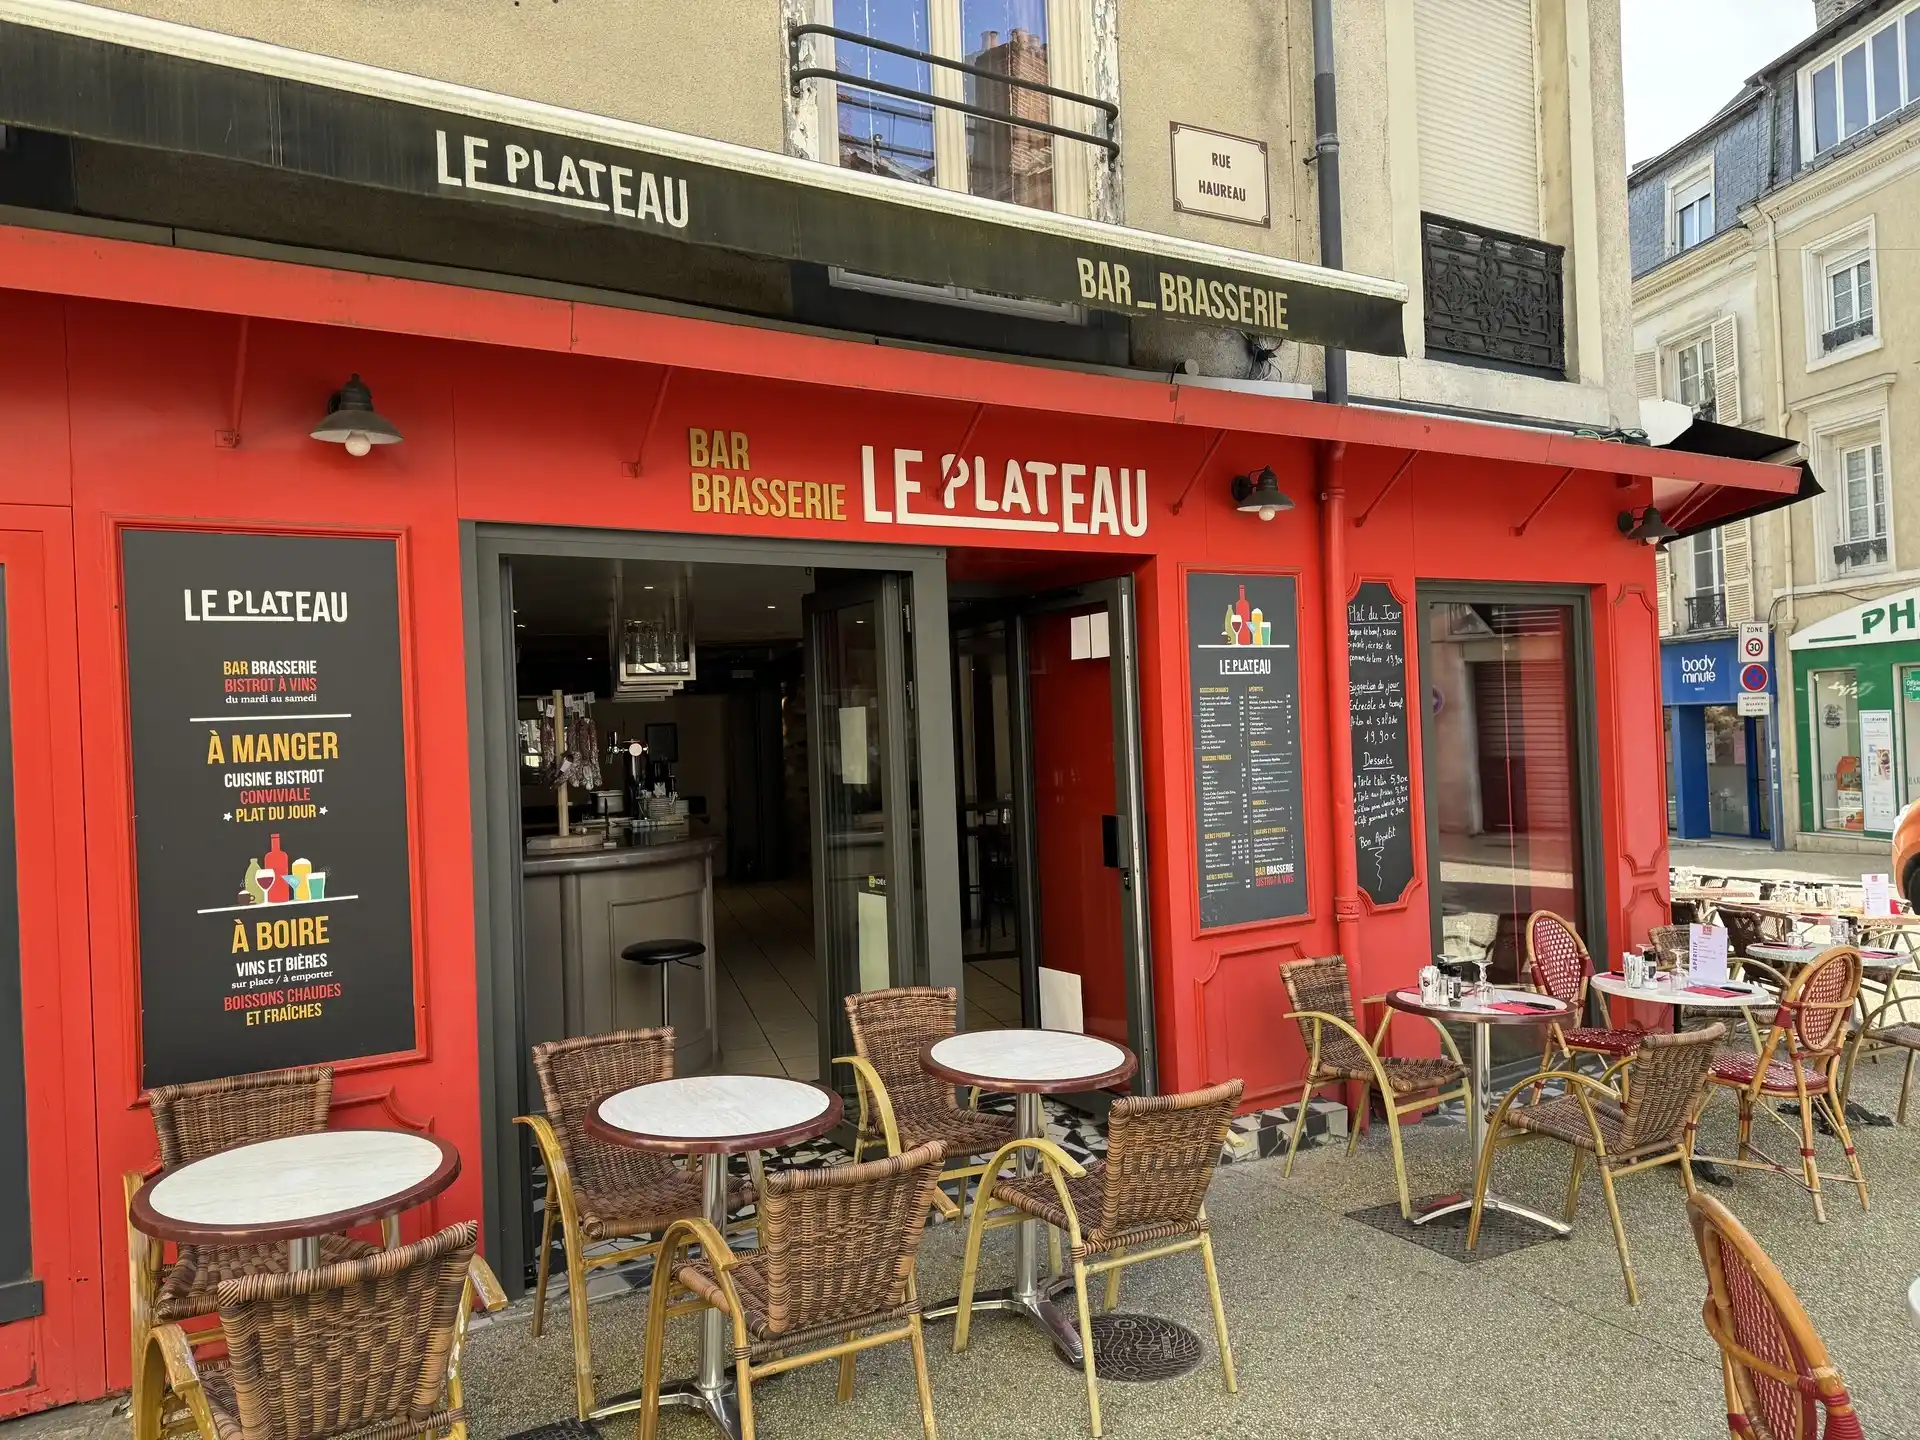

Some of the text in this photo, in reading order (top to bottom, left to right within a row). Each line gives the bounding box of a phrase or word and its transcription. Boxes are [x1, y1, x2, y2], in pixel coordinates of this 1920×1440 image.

[1211, 152, 1231, 169] RUE
[436, 130, 689, 229] LE PLATEAU
[1198, 180, 1246, 202] HAUREAU
[689, 428, 750, 470] BAR
[691, 473, 847, 521] BRASSERIE
[861, 445, 1149, 538] LE PLATEAU
[184, 589, 348, 623] LE PLATEAU
[1348, 604, 1402, 622] Plat du Jour
[1861, 598, 1920, 635] PH
[1385, 640, 1392, 650] de
[1749, 643, 1760, 652] 30
[223, 660, 318, 675] BAR BRASSERIE
[1219, 658, 1271, 675] LE PLATEAU
[1681, 654, 1716, 672] body
[225, 675, 318, 693] BISTROT À VINS
[1682, 671, 1716, 684] minute
[1377, 679, 1385, 690] du
[1385, 679, 1400, 696] jour
[225, 695, 239, 704] du
[241, 694, 269, 703] mardi
[284, 693, 317, 703] samedi
[1379, 698, 1386, 709] de
[1376, 711, 1398, 725] salade
[207, 729, 339, 765] À MANGER
[1362, 751, 1393, 768] Desserts
[224, 769, 325, 788] CUISINE BISTROT
[240, 787, 311, 805] CONVIVIALE
[236, 804, 317, 823] PLAT DU JOUR
[1359, 835, 1371, 849] Bon
[1255, 863, 1295, 876] BAR BRASSERIE
[1255, 875, 1277, 887] BISTROT
[231, 915, 330, 954] À BOIRE
[236, 953, 328, 977] VINS ET BIÈRES
[231, 981, 247, 990] sur
[249, 977, 275, 989] place
[283, 974, 290, 983] à
[291, 970, 334, 985] emporter
[224, 982, 342, 1012] BOISSONS CHAUDES
[246, 1002, 322, 1027] ET FRAÎCHES
